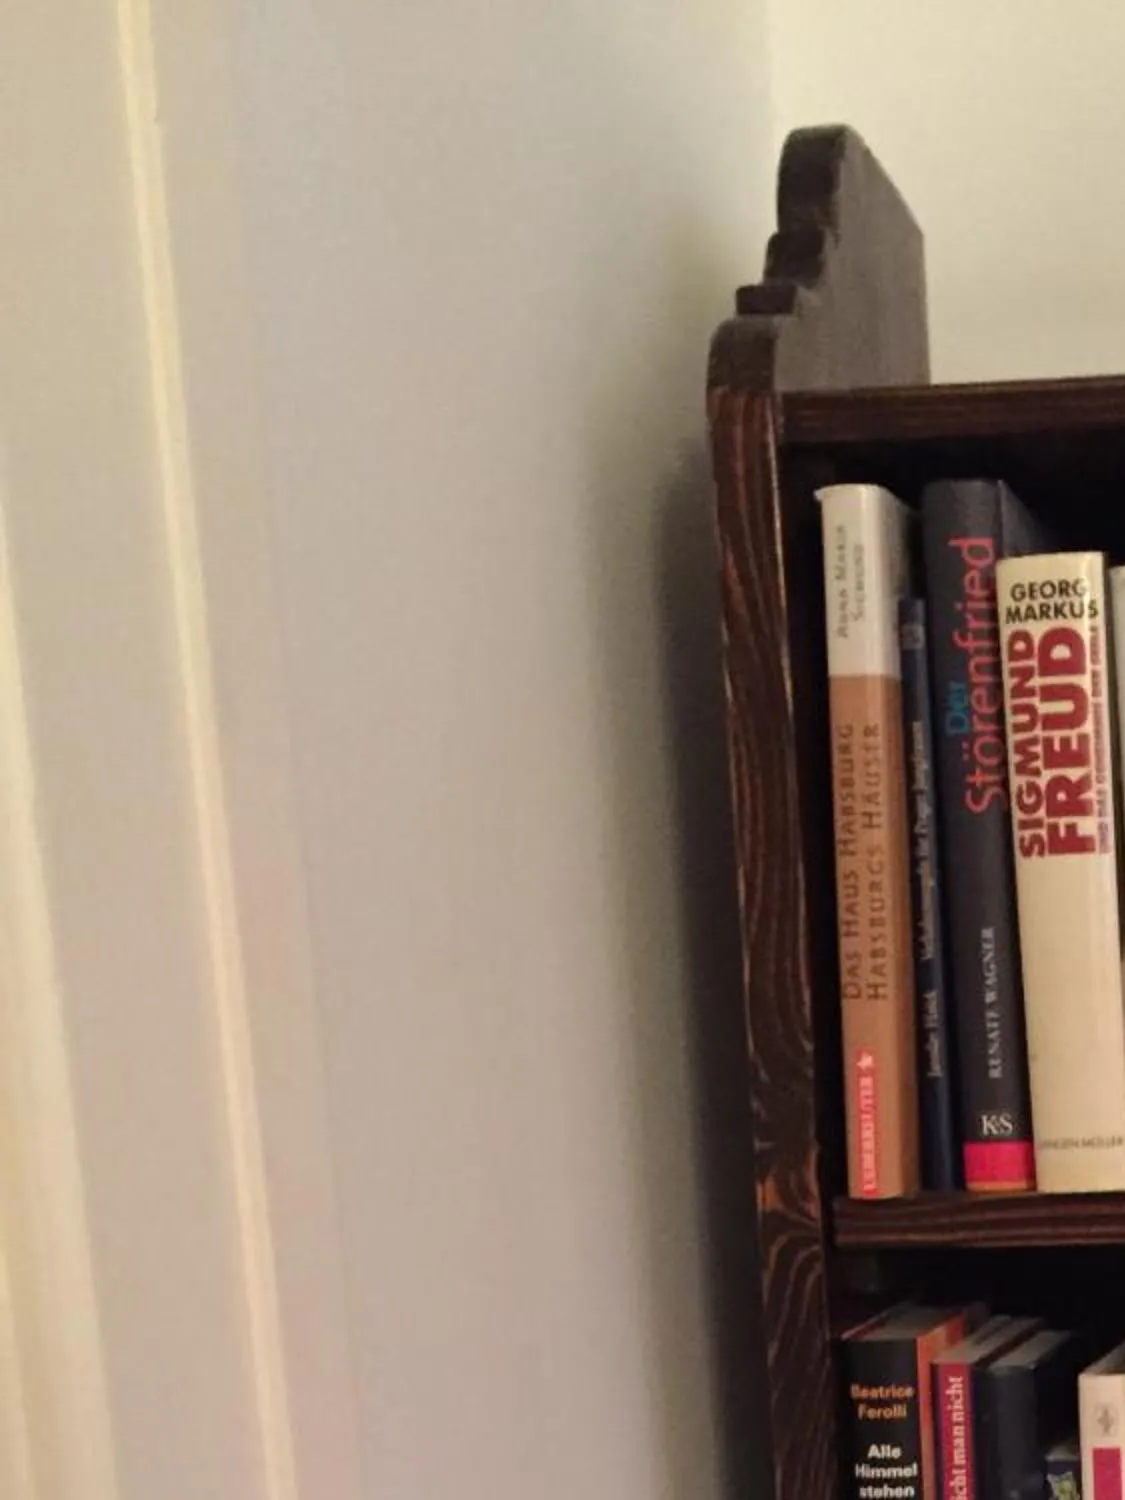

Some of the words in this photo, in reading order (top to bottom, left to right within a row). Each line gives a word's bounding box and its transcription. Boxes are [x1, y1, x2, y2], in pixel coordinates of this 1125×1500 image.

[1009, 578, 1089, 603] GEORG
[1004, 600, 1099, 626] MARKUS
[946, 536, 1004, 814] Störenfried
[944, 681, 968, 736] Der
[1006, 628, 1044, 859] SIGMUND
[1037, 625, 1097, 857] FREUD
[835, 723, 860, 858] HABSBURG
[838, 870, 862, 941] HAUS
[979, 926, 1000, 1006] WAGNER
[850, 1383, 915, 1400] Beatrice
[858, 1403, 908, 1421] Ferolli
[944, 1375, 966, 1420] nicht
[867, 1443, 903, 1461] Alle
[953, 1423, 968, 1467] man
[855, 1461, 918, 1480] Himmel
[859, 1482, 916, 1500] stehen
